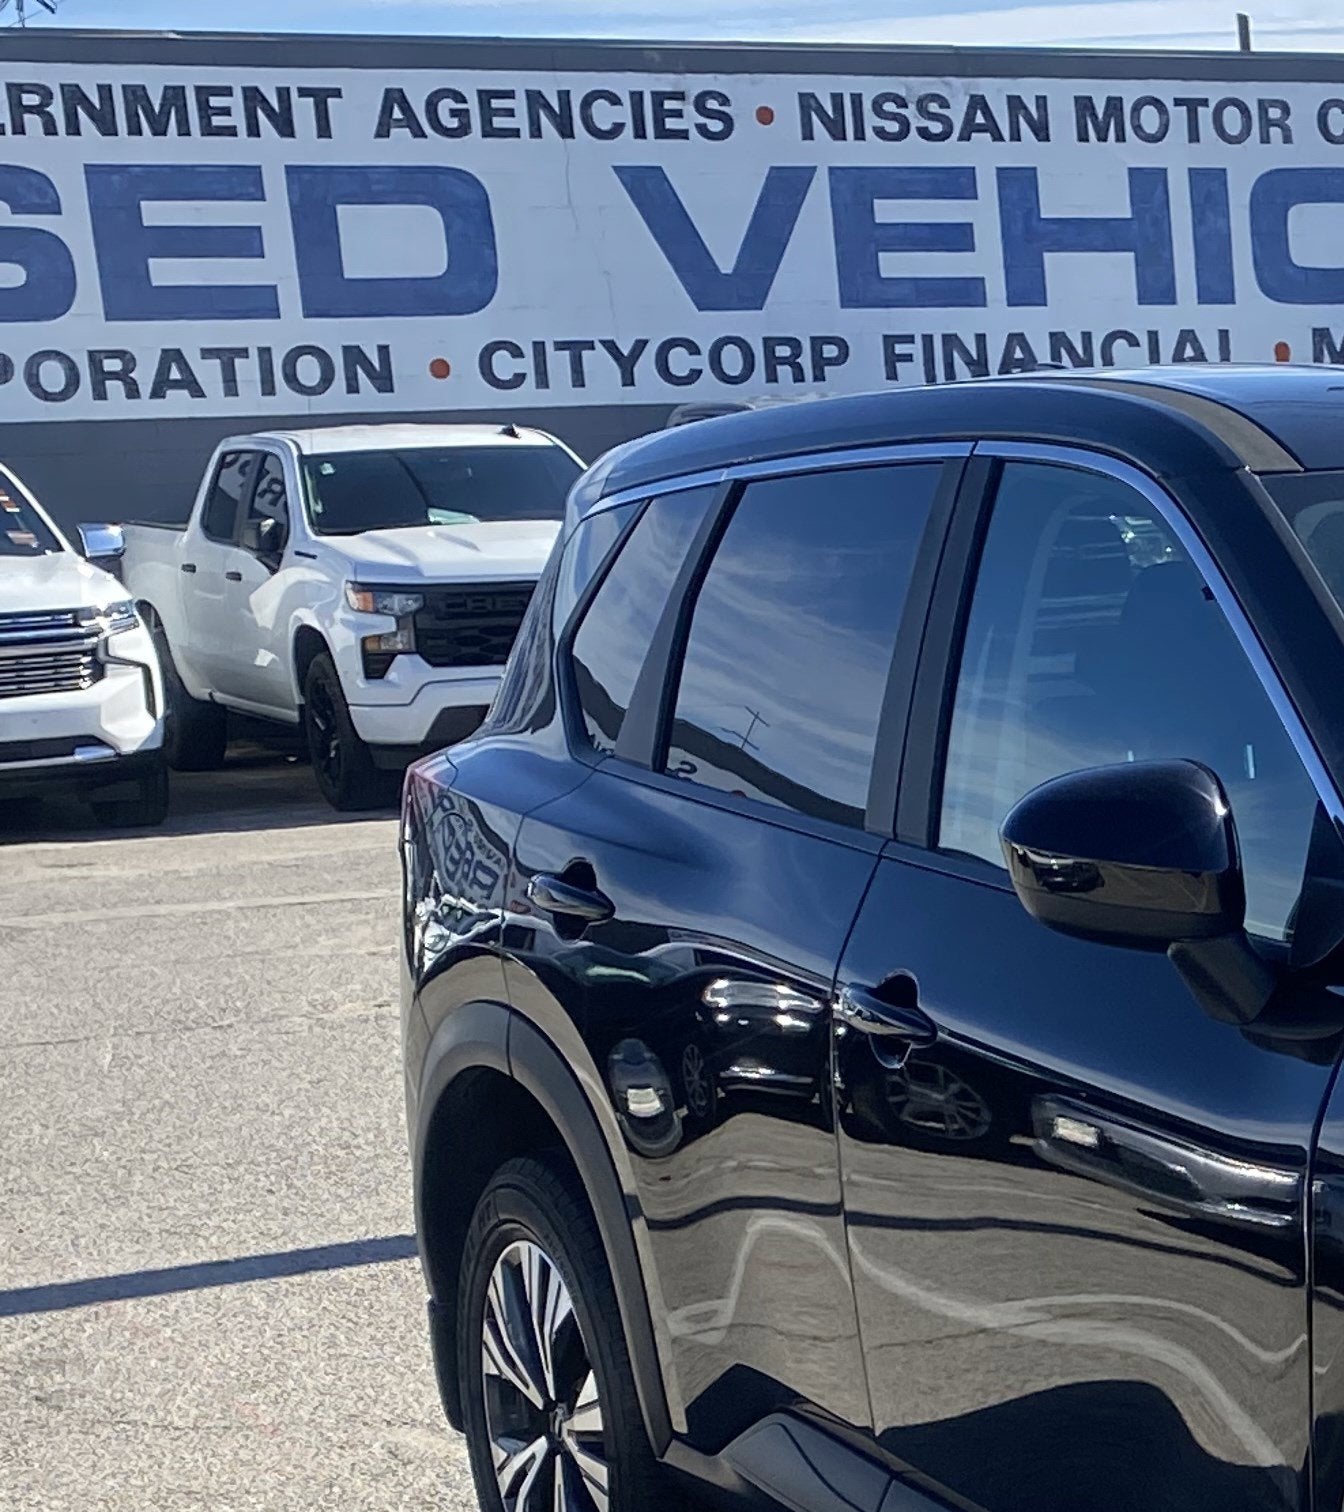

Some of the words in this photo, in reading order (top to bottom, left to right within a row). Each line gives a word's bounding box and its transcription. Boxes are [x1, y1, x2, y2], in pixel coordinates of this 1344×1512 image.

[0, 82, 342, 138] RNMENT
[374, 87, 734, 142] AGENCIES
[799, 91, 1050, 143] NISSAN
[1075, 95, 1293, 144] MOTOR
[478, 335, 850, 390] CITYCORP
[882, 328, 1231, 385] FINANCIAL
